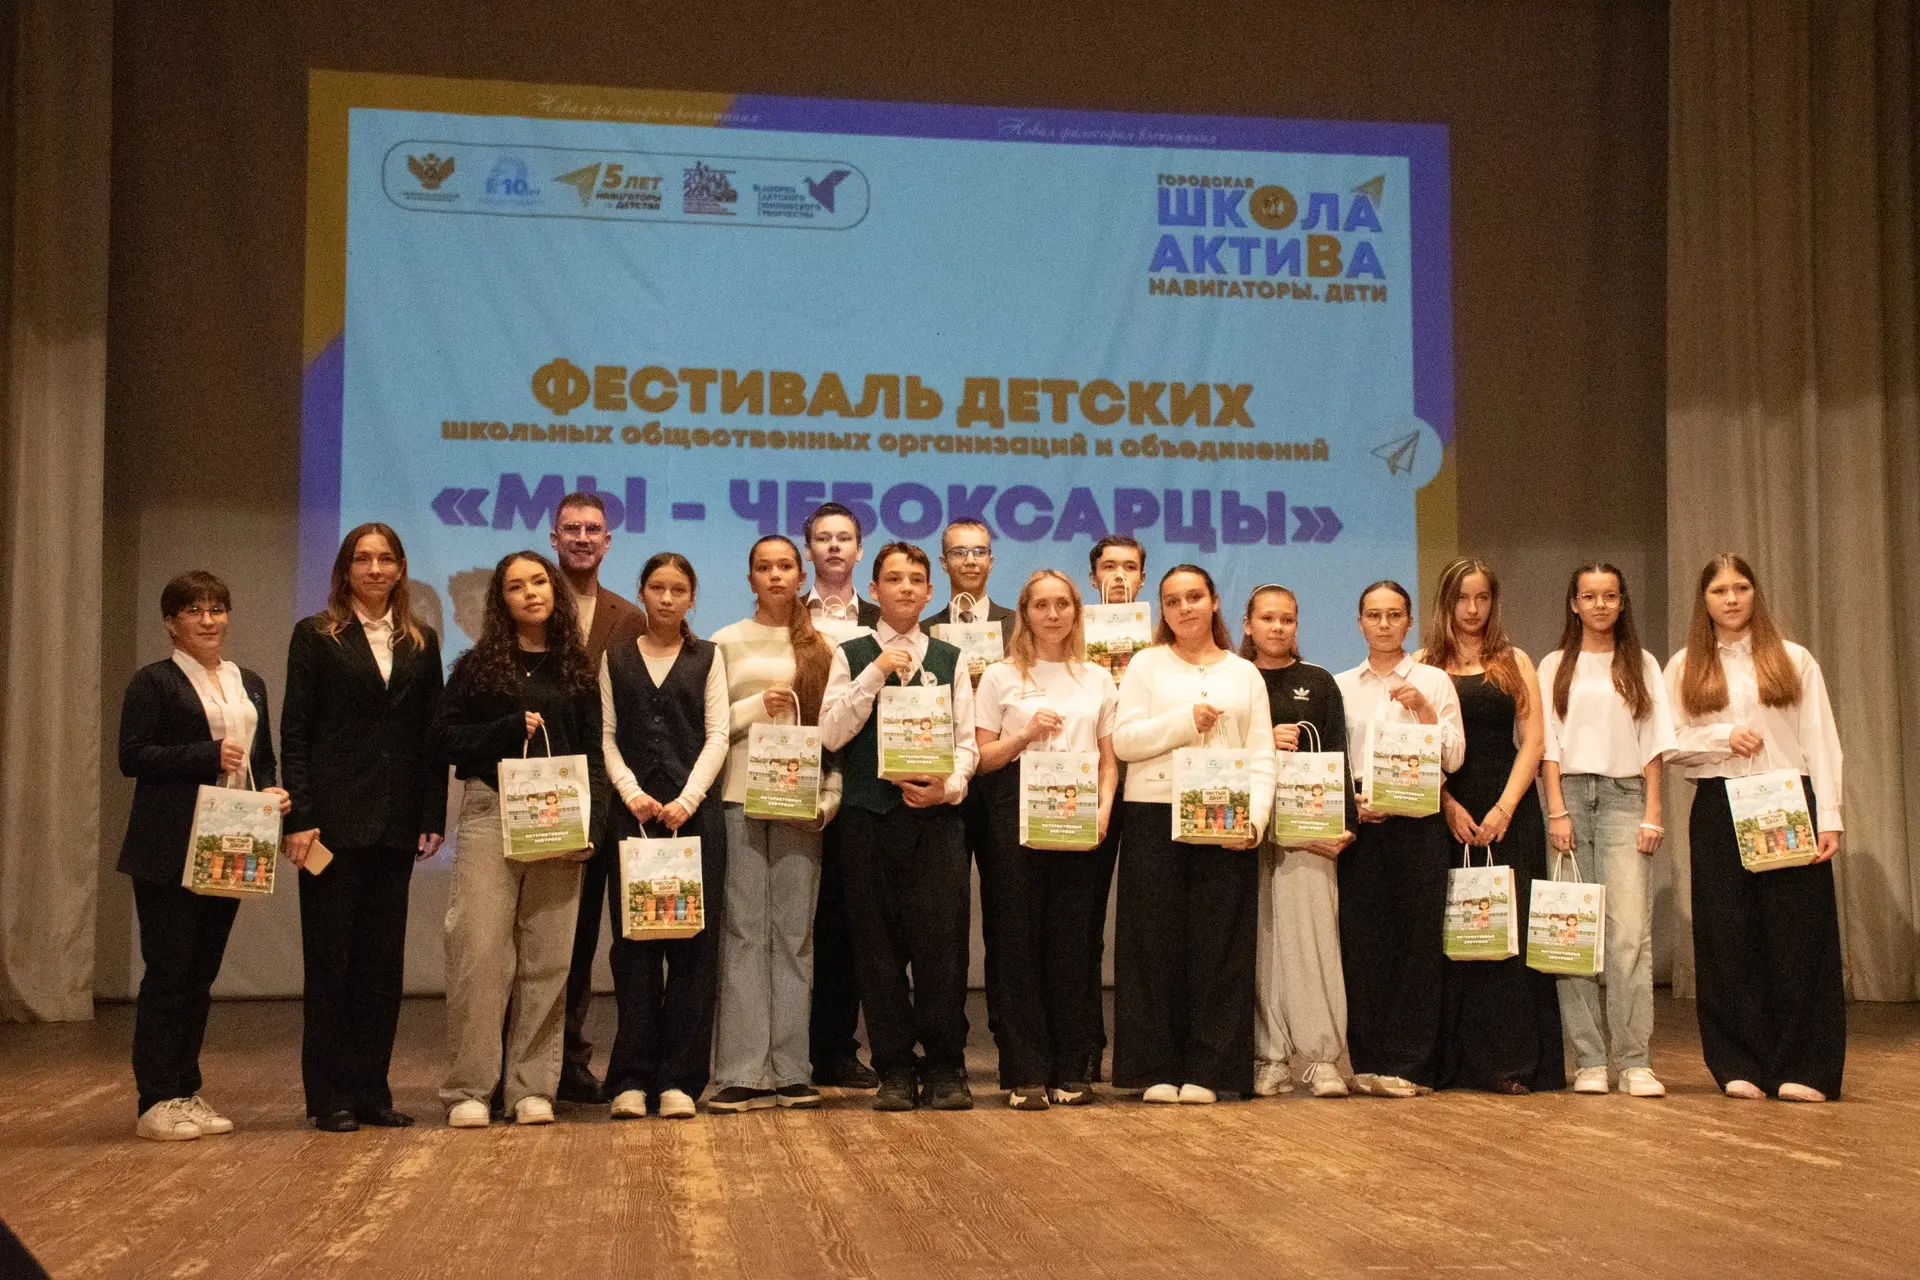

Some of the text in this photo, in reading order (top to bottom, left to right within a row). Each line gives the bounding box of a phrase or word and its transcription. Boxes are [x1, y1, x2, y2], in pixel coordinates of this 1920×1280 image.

[504, 178, 528, 195] 10
[602, 163, 624, 189] 5
[625, 176, 664, 190] ЛЕТ
[1156, 173, 1256, 190] ГОРОДСКАЯ
[596, 191, 663, 203] НАВИГАТОРЫ
[615, 201, 661, 210] ДЕТСТВА
[1156, 184, 1384, 233] ШКОЛА
[1148, 233, 1387, 280] АКТИВА
[1324, 283, 1388, 304] ДЕТИ
[531, 357, 1256, 429] ФЕСТИВАЛЬ ДЕТСКИХ
[441, 419, 1330, 463] школьных общественных организаций и объединений
